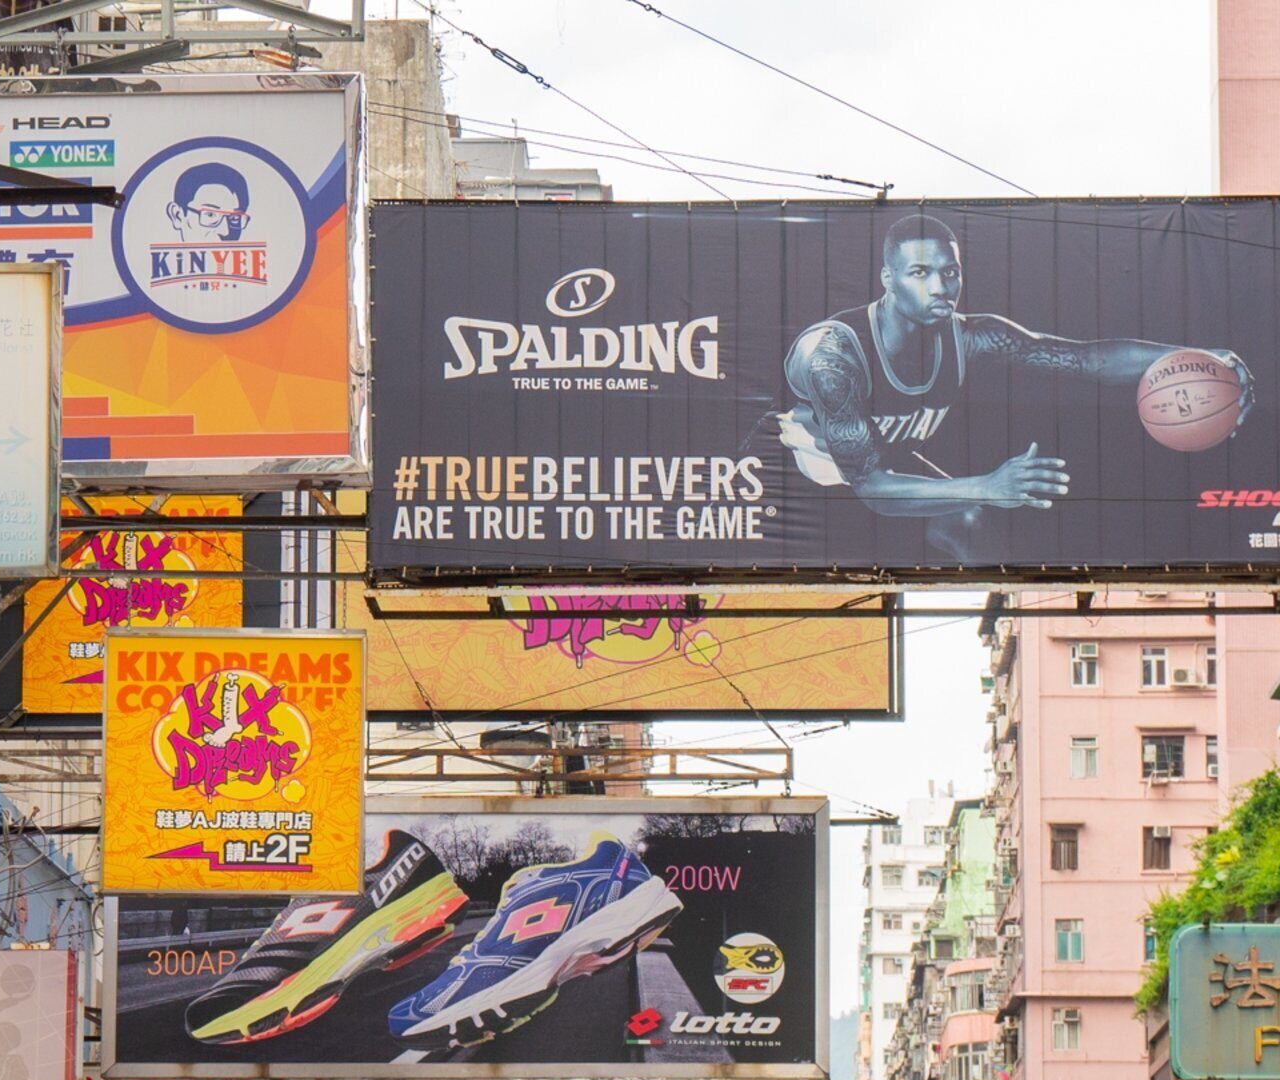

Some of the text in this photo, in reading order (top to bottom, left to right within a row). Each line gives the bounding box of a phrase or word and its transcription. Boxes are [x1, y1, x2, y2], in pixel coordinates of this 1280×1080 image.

[12, 116, 110, 129] HEAD
[50, 143, 108, 163] YONEX
[443, 315, 719, 380] SPALDING
[511, 377, 649, 391] TRUE TO THE GAME
[393, 455, 764, 502] #TRUEBELIEVERS
[392, 505, 764, 540] ARE TRUE TO THE GAME
[116, 651, 353, 684] KIX DREAMS
[155, 809, 313, 831] 鞋夢AJ波鞋專門店
[223, 834, 311, 864] 請上2F
[664, 865, 741, 891] 200W
[146, 950, 236, 976] 300AP
[669, 1011, 781, 1034] lotto
